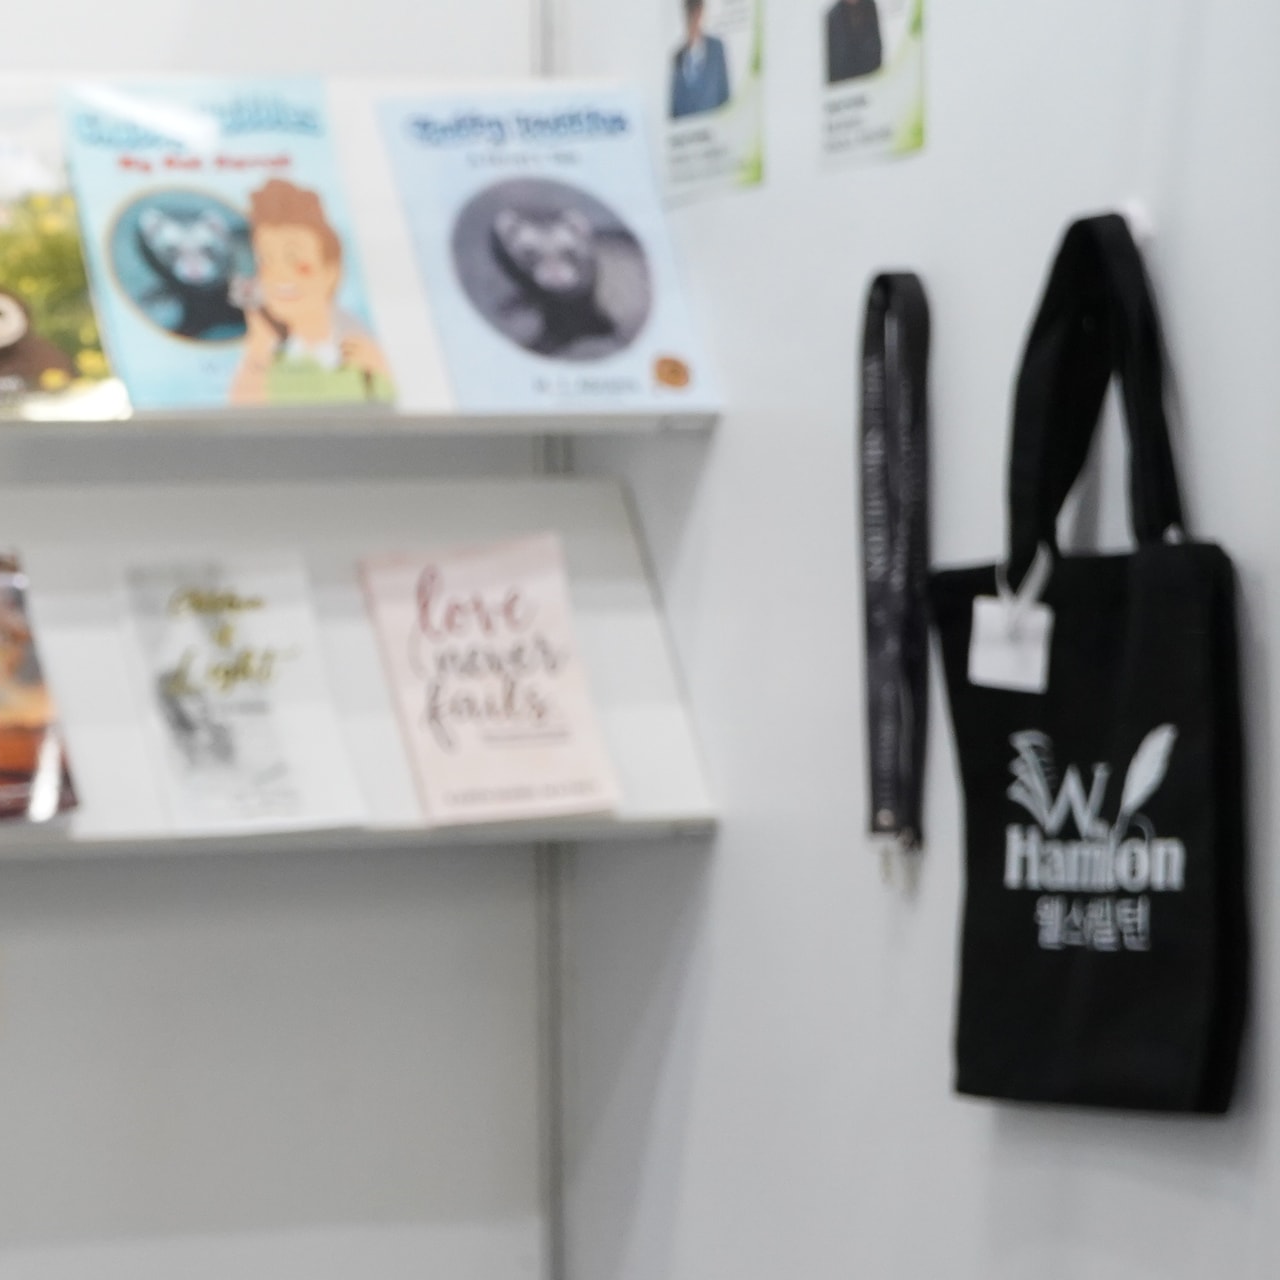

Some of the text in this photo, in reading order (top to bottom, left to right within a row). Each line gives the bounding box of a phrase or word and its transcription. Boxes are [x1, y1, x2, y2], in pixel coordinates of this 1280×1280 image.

[416, 564, 526, 642] love
[430, 631, 570, 678] never
[422, 674, 547, 754] fails
